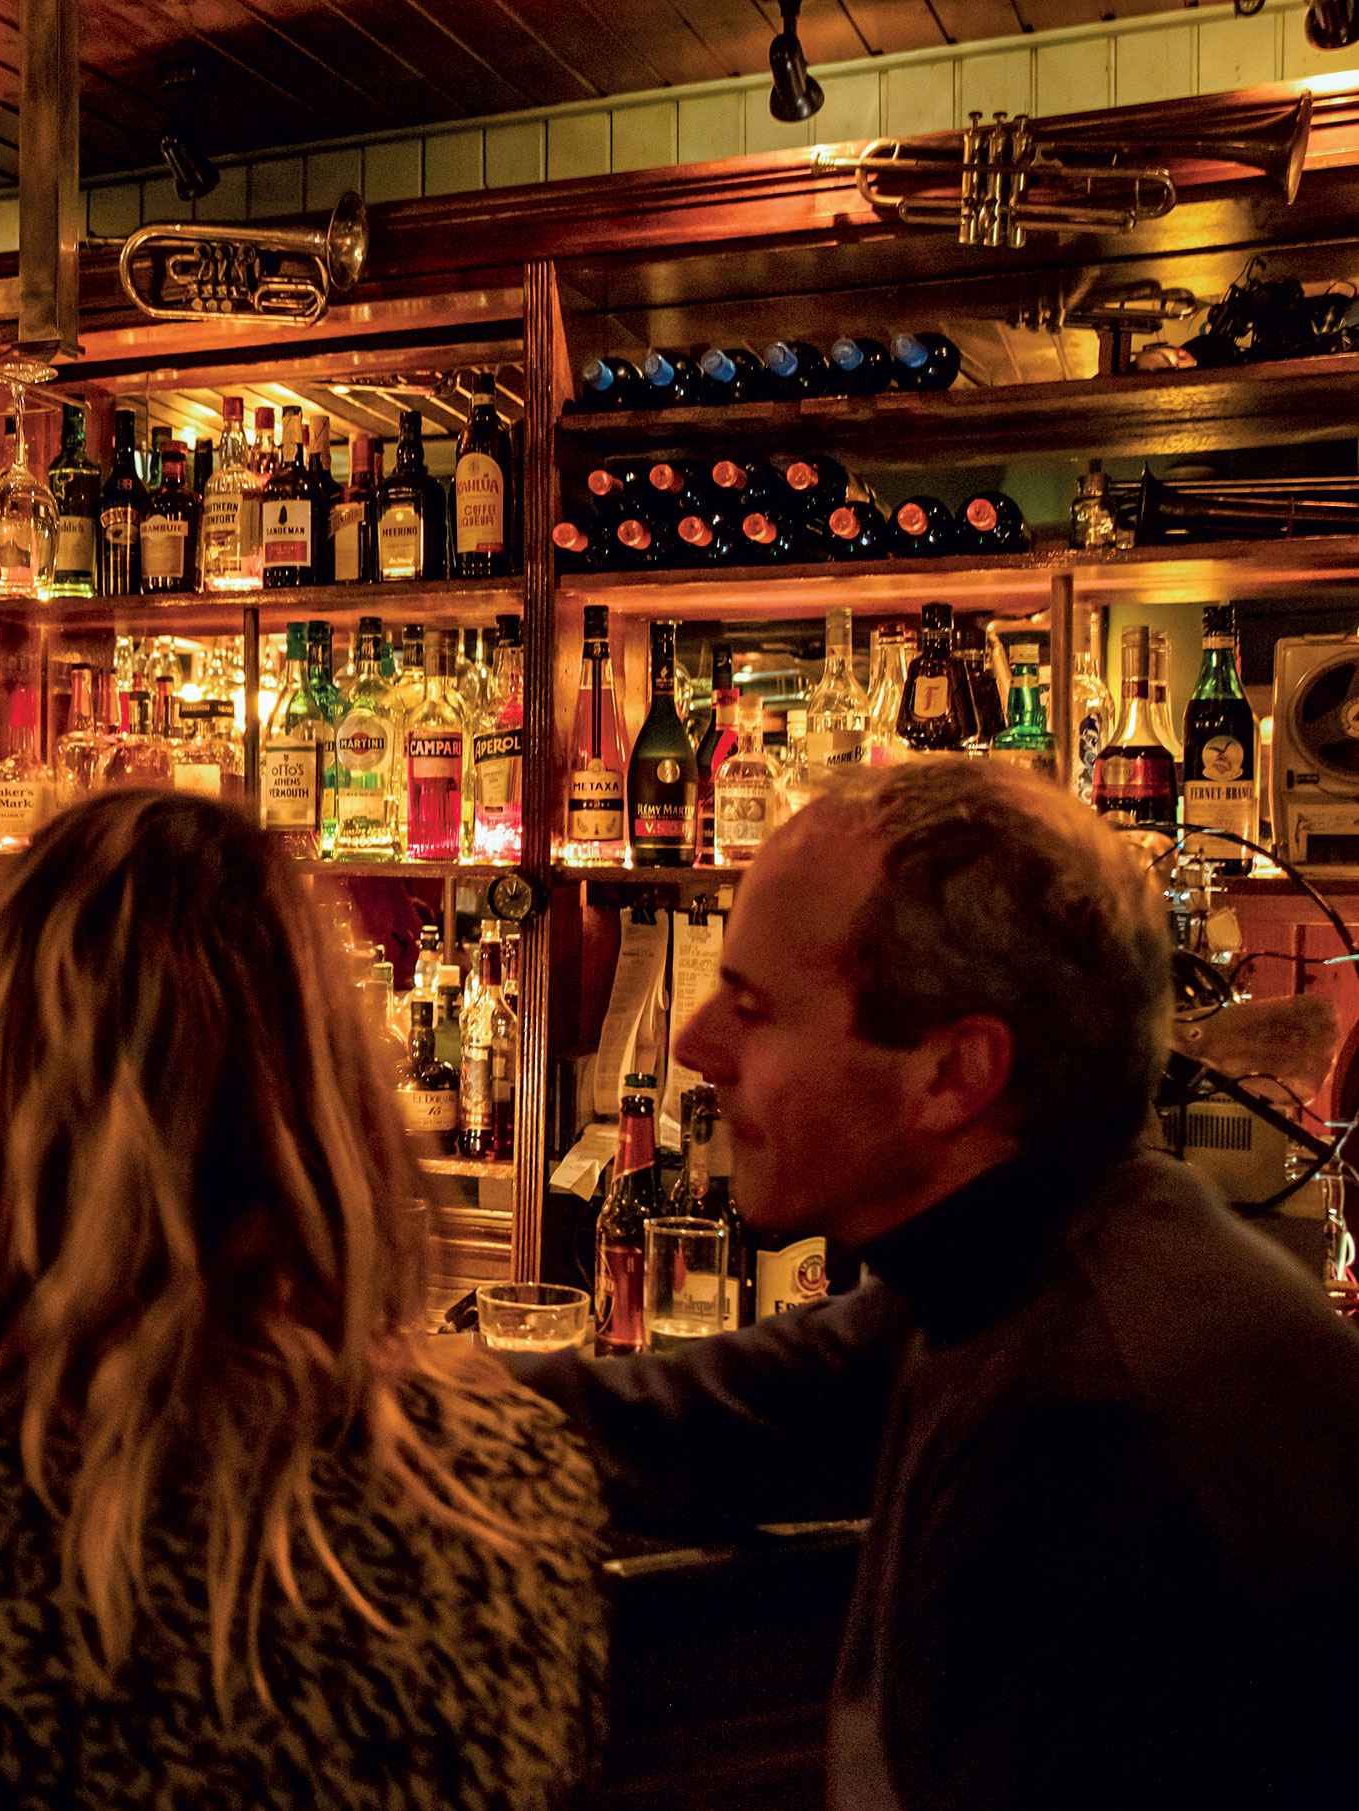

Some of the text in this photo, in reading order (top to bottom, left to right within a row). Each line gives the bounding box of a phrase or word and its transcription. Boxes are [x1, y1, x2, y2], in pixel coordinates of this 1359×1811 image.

[266, 527, 305, 536] SANDEMAN
[382, 526, 418, 538] HEERING
[340, 738, 384, 749] MARTINI
[410, 740, 461, 756] CAMPARI
[475, 736, 522, 760] APEROL
[273, 778, 301, 787] ATHENS
[269, 788, 309, 798] VERMOUTH
[0, 799, 34, 808] Mark
